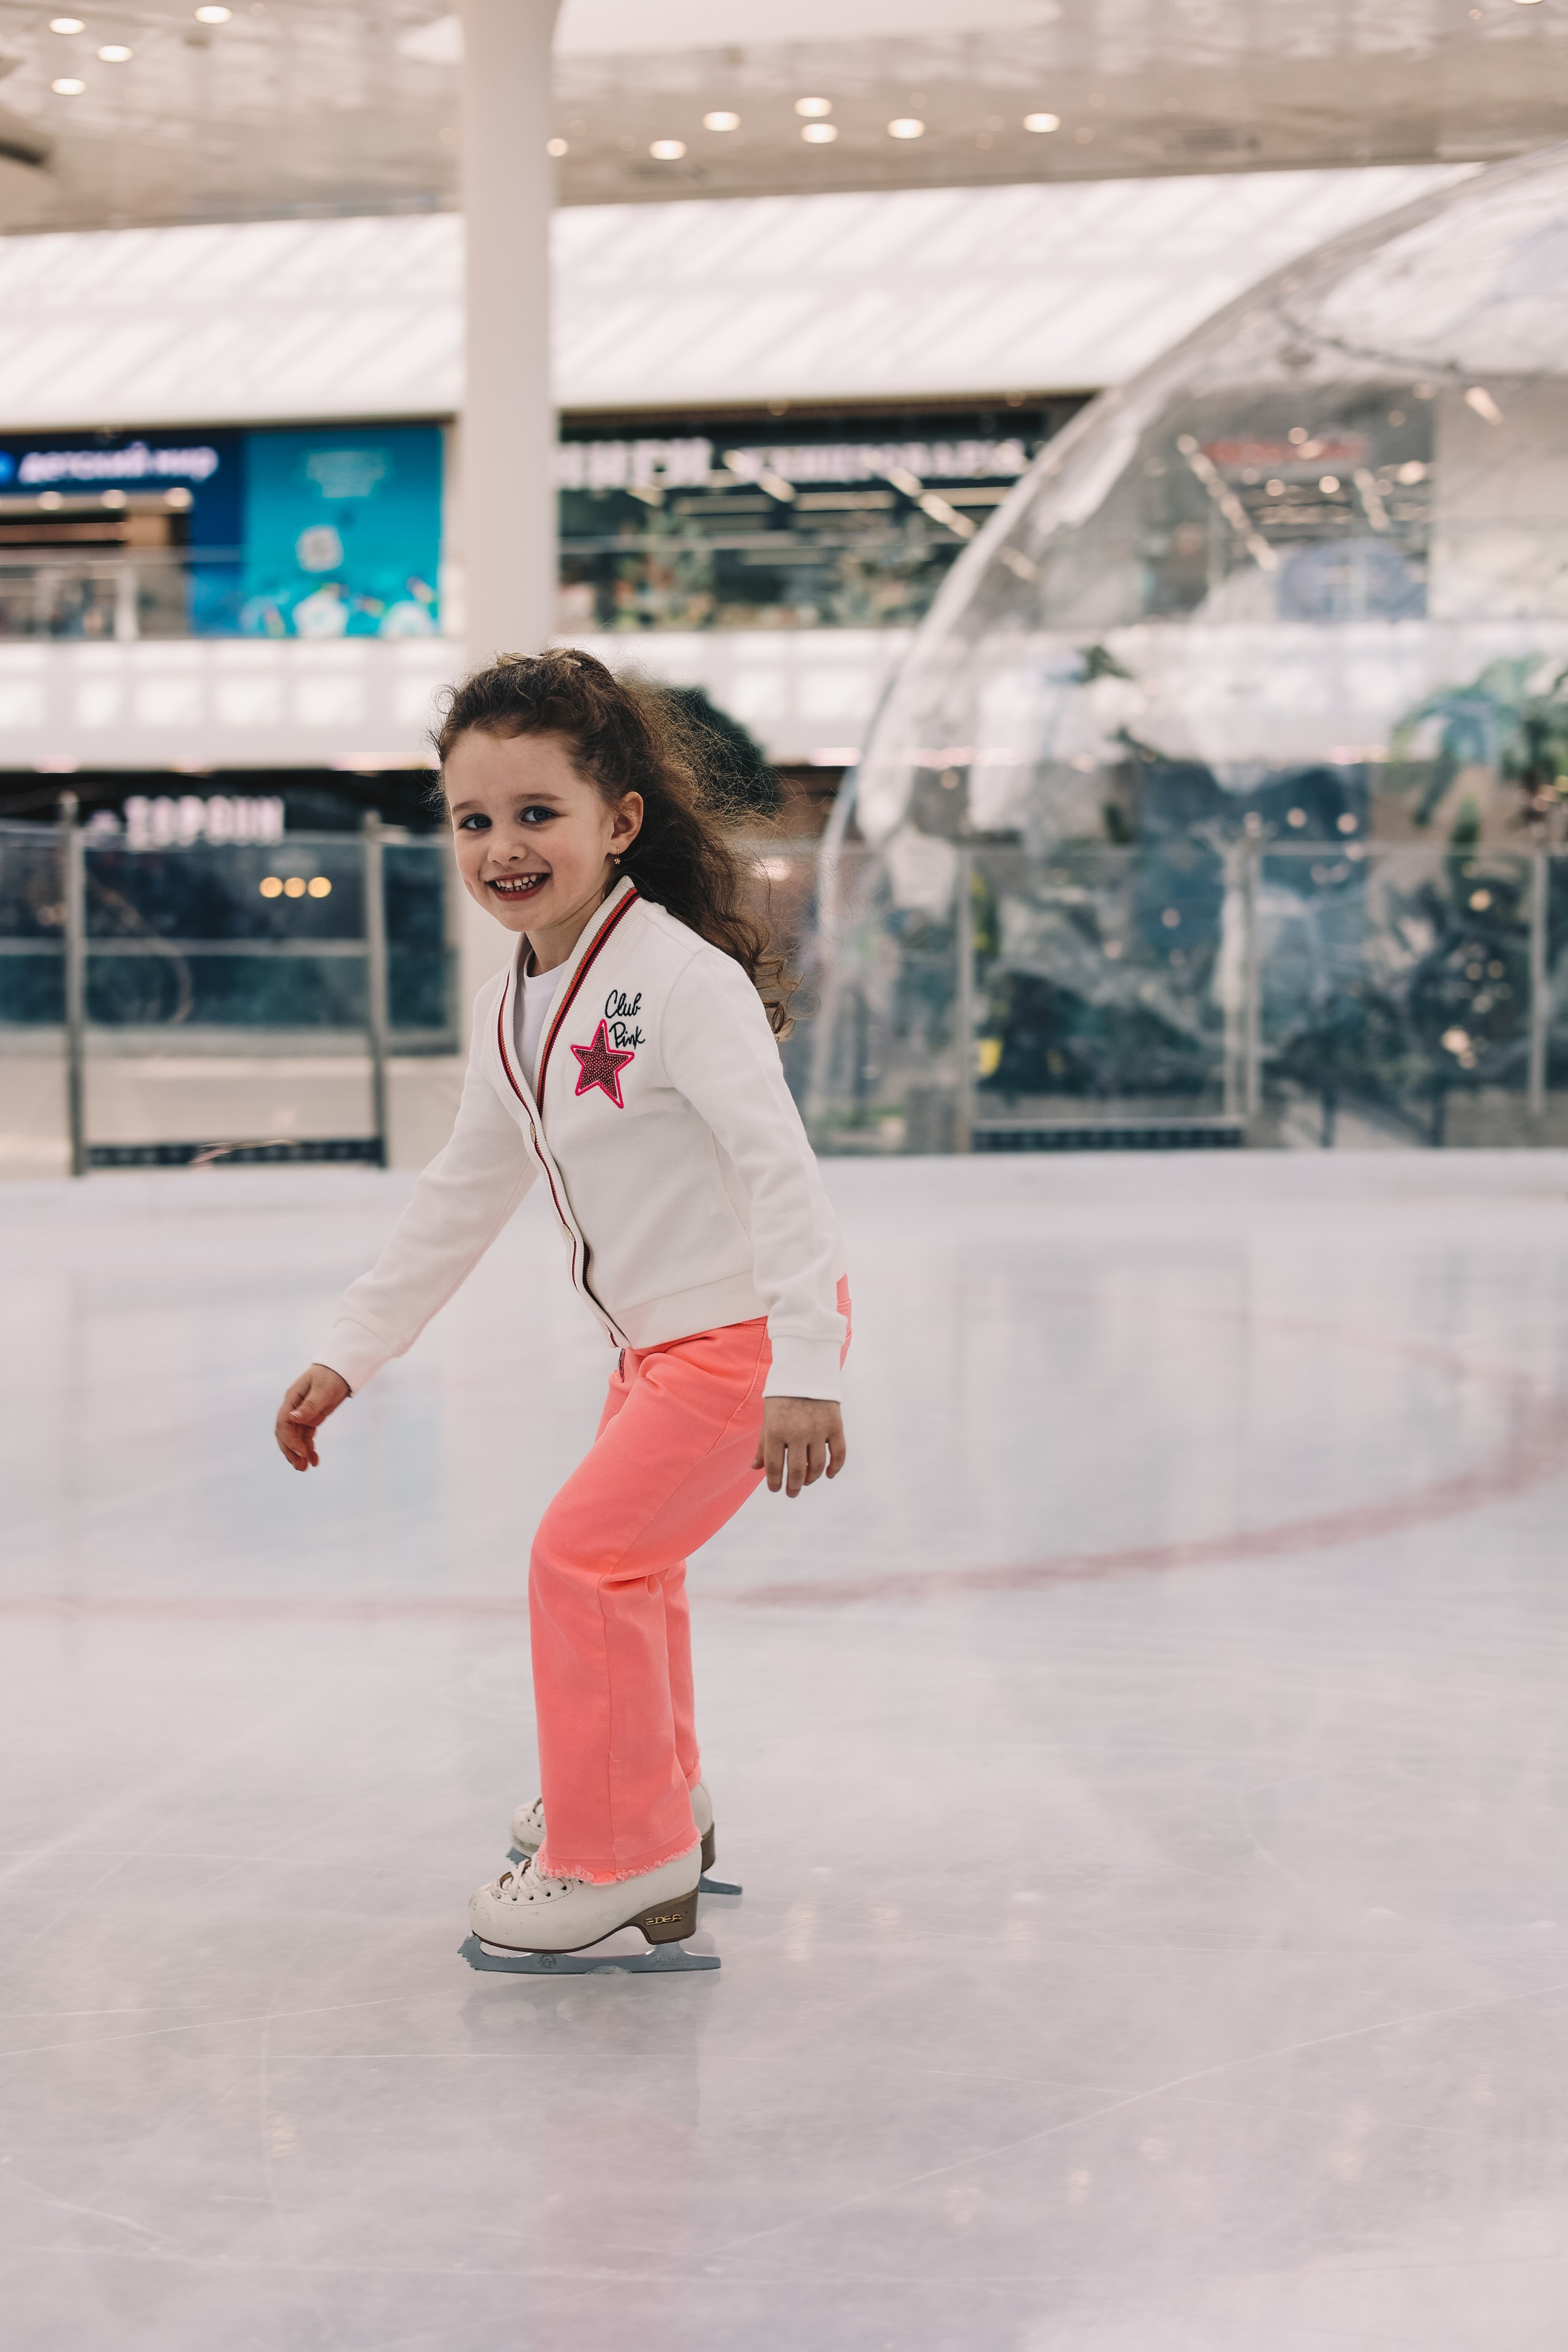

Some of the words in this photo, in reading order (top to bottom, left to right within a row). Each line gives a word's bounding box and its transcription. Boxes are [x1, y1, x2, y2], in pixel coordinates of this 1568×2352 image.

[605, 989, 642, 1019] Club
[608, 1021, 646, 1049] Pink
[644, 1914, 682, 1926] EDEA
